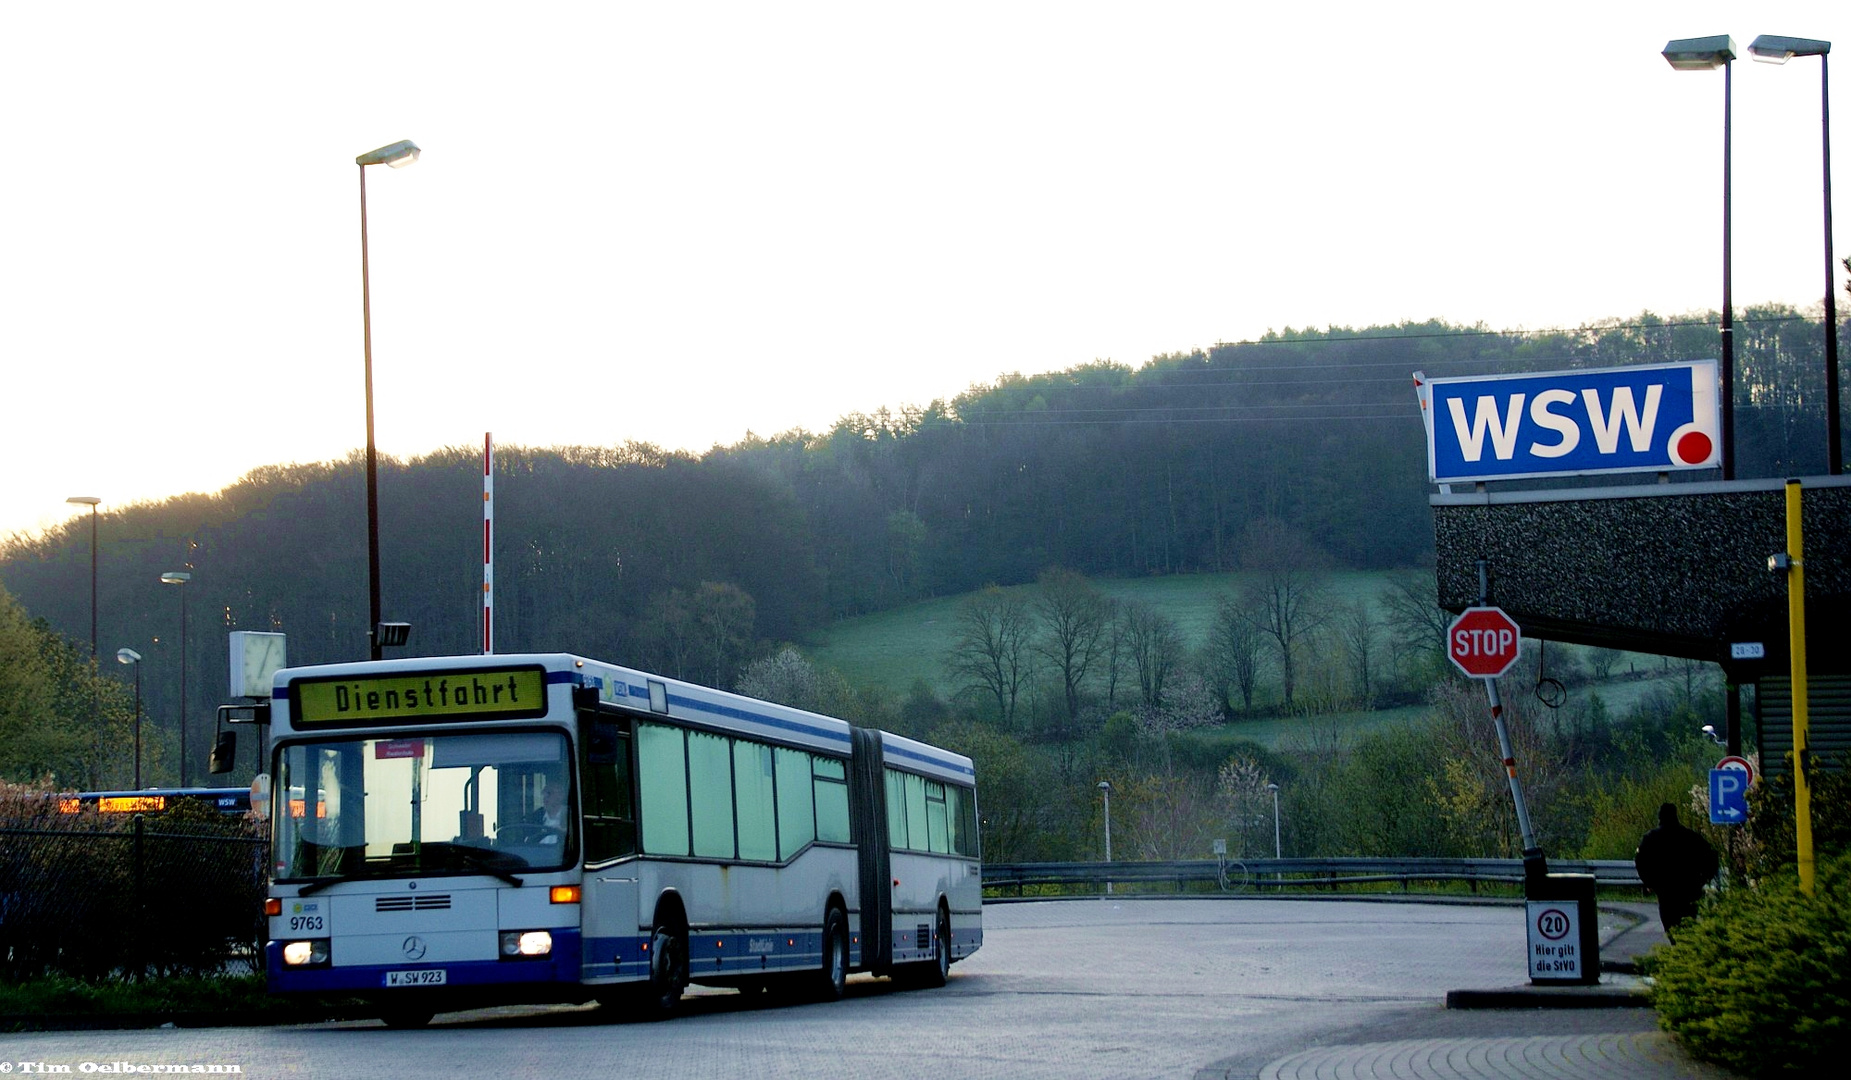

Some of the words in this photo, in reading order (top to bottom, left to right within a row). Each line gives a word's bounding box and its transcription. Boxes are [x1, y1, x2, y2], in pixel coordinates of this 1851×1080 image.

[1455, 629, 1513, 657] STOP
[335, 676, 520, 713] Dienstfahrt
[1717, 775, 1740, 806] P
[217, 798, 236, 806] WSW
[290, 916, 323, 931] 9763
[1544, 916, 1563, 933] 20
[1535, 944, 1557, 956] Hier
[1558, 944, 1575, 958] gilt
[1536, 960, 1552, 972] die
[1553, 960, 1576, 972] StVO
[390, 973, 399, 985] W
[405, 972, 420, 984] SW
[421, 971, 442, 983] 923
